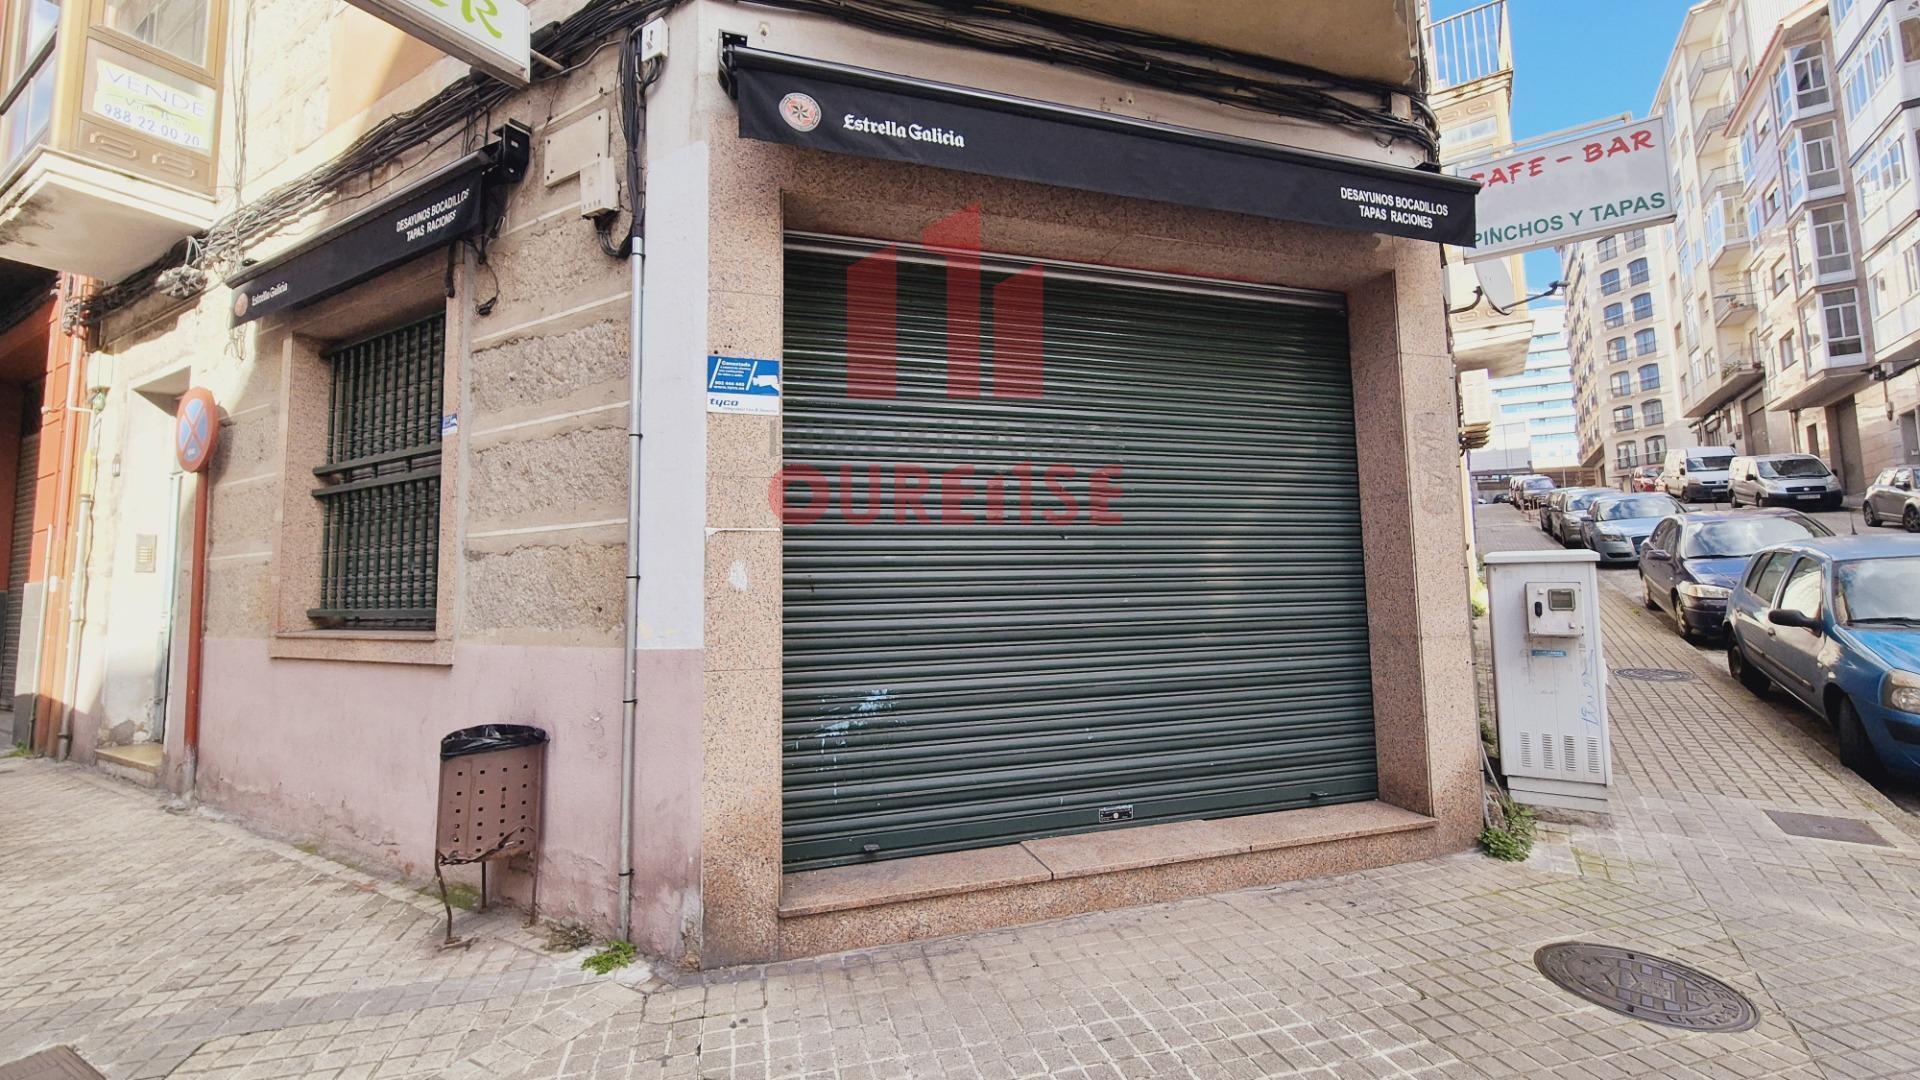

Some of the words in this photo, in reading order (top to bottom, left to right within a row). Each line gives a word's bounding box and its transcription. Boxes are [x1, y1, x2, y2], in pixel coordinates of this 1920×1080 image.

[106, 68, 206, 117] VENDE
[104, 103, 132, 124] 988
[138, 115, 156, 132] 22
[160, 125, 178, 140] 00
[183, 131, 201, 147] 20
[842, 113, 907, 139] Estrella
[908, 124, 966, 149] Galicia
[1582, 130, 1655, 163] BAR
[395, 206, 432, 233] DESAYUNOS
[430, 187, 471, 217] BOCADILLOS
[1340, 186, 1395, 207] DESAYUNOS
[1395, 196, 1449, 217] BOCADILLOS
[1358, 204, 1387, 221] TAPAS
[1390, 210, 1433, 230] RACIONES
[1568, 209, 1584, 227] Y
[1589, 192, 1666, 222] TAPAS
[406, 224, 426, 243] TAPAS
[426, 208, 458, 234] RACIONES
[710, 398, 739, 407] tyco
